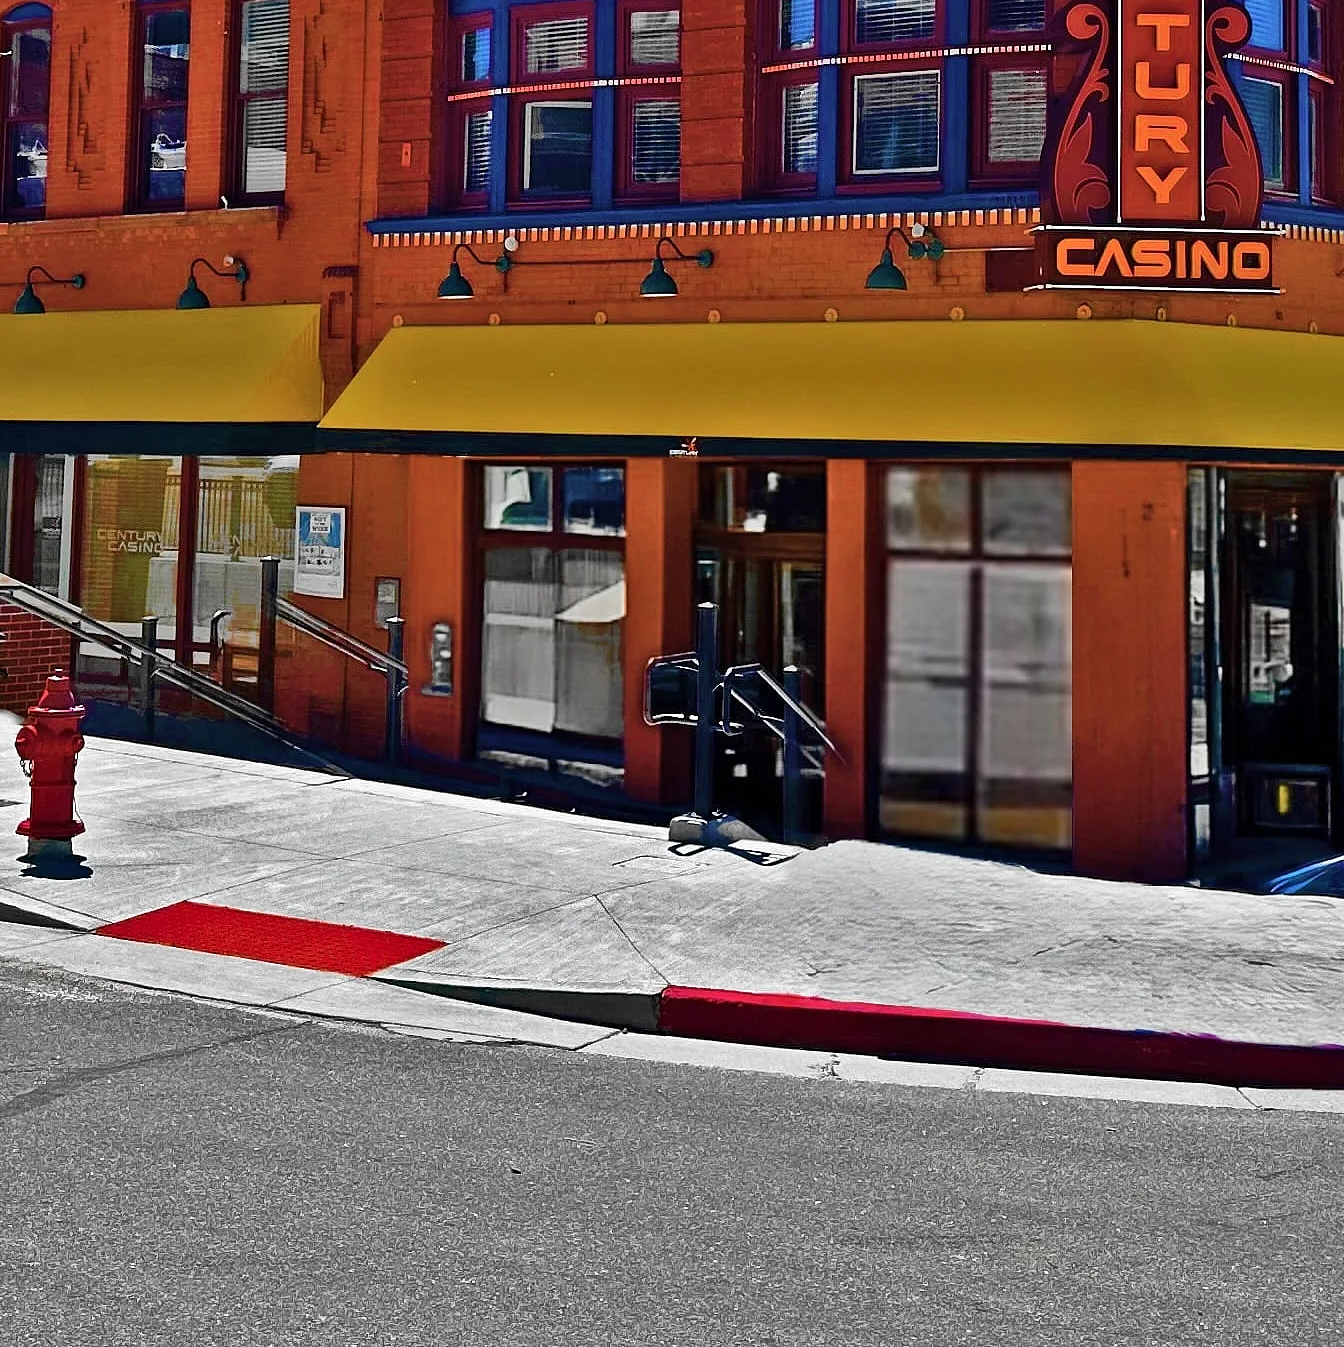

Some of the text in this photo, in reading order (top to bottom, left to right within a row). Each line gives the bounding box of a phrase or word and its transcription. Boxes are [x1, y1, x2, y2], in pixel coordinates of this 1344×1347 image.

[1057, 238, 1270, 280] CASINO
[96, 528, 162, 542] CENTURY
[108, 541, 162, 553] CASINO
